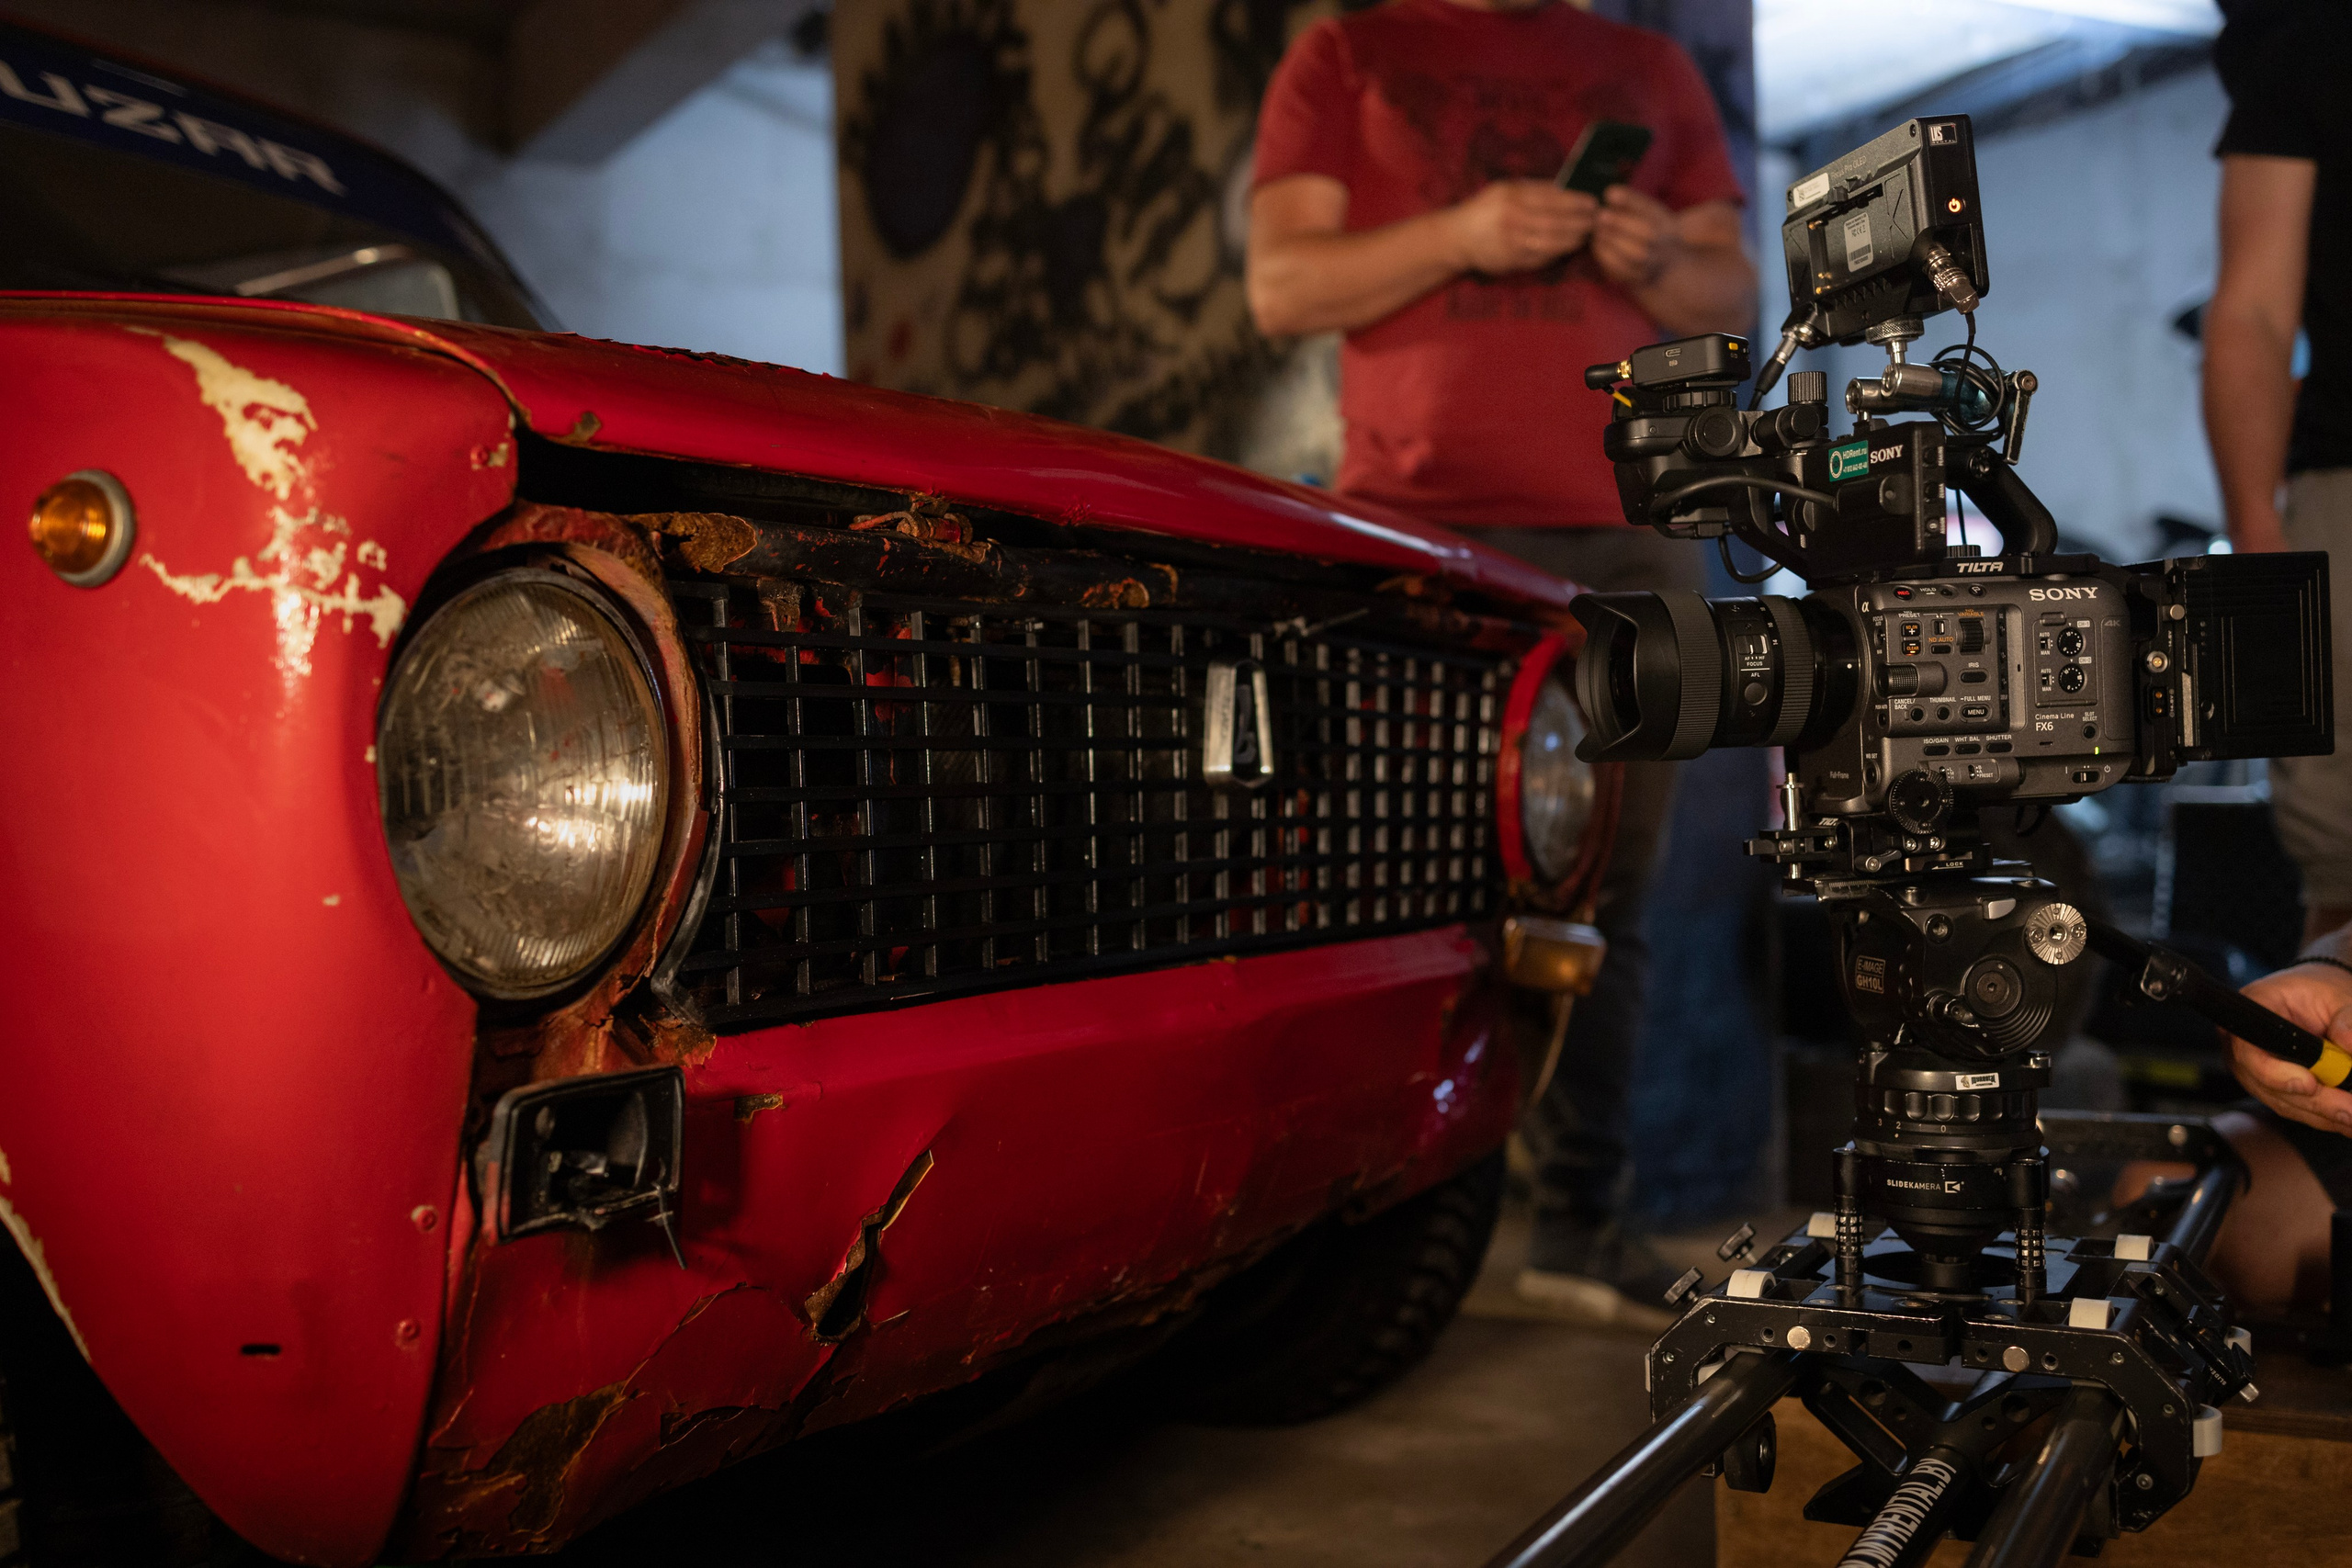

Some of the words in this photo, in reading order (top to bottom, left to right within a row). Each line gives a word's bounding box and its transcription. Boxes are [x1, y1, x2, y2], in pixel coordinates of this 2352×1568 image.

[1870, 445, 1904, 464] SONY
[1957, 561, 2004, 573] TILTA
[2029, 587, 2098, 601] SONY
[2036, 722, 2053, 731] FX6
[1818, 818, 1838, 826] TILT
[1857, 975, 1883, 990] GH10L
[1878, 1118, 1883, 1126] 3
[1887, 1179, 1940, 1190] SLIDEKAMERA
